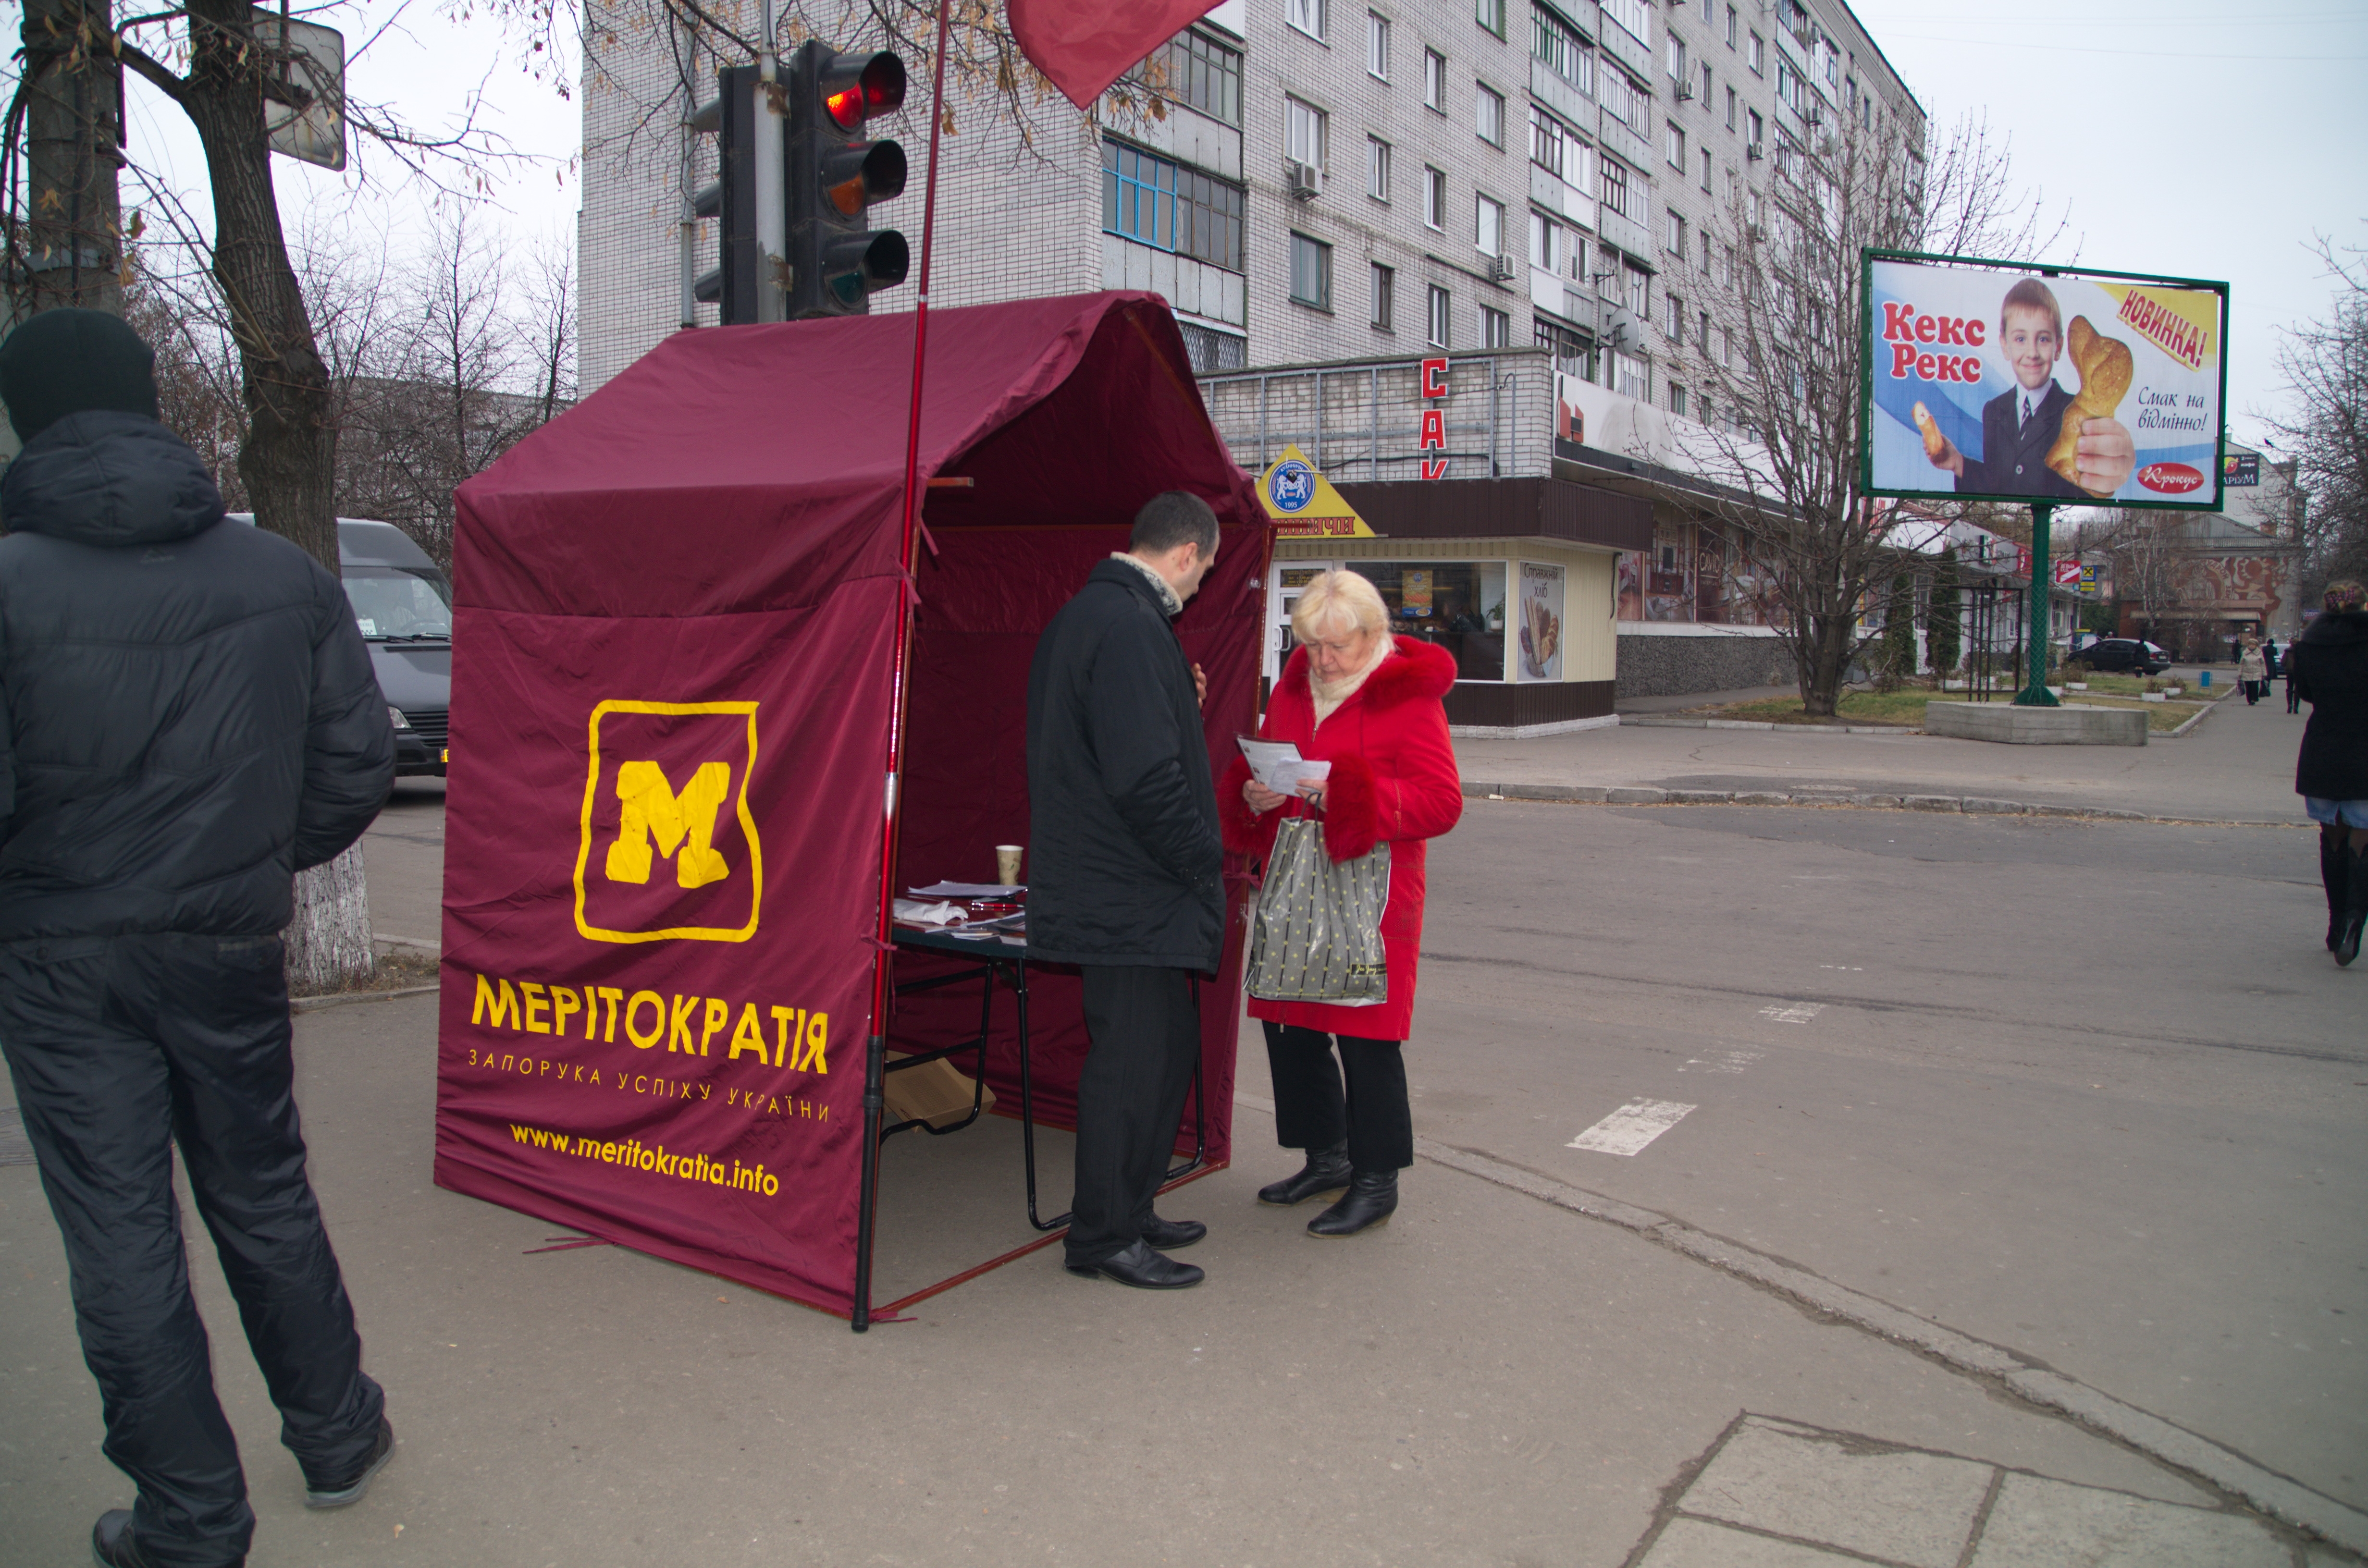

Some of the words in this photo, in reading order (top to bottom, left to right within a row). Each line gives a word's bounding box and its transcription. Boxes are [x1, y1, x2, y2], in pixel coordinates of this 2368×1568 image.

[1884, 303, 1985, 346] Кекс
[2117, 289, 2207, 369] НОВИНКА!
[1891, 343, 1981, 383] Рекс
[2138, 386, 2177, 407] Смак
[2187, 395, 2204, 409] на
[2138, 408, 2207, 431] відмінно!
[2144, 466, 2198, 490] Крокус
[1524, 563, 1558, 583] Справжній
[1534, 582, 1547, 598] хліб
[471, 974, 828, 1074] МЕРІТОКРАТІЯ
[469, 1049, 600, 1085] ЗАПОРУКА
[618, 1072, 711, 1100] УСПІХУ
[727, 1088, 828, 1123] УКРАЇНИ
[510, 1124, 778, 1196] www.meritokratia.info
